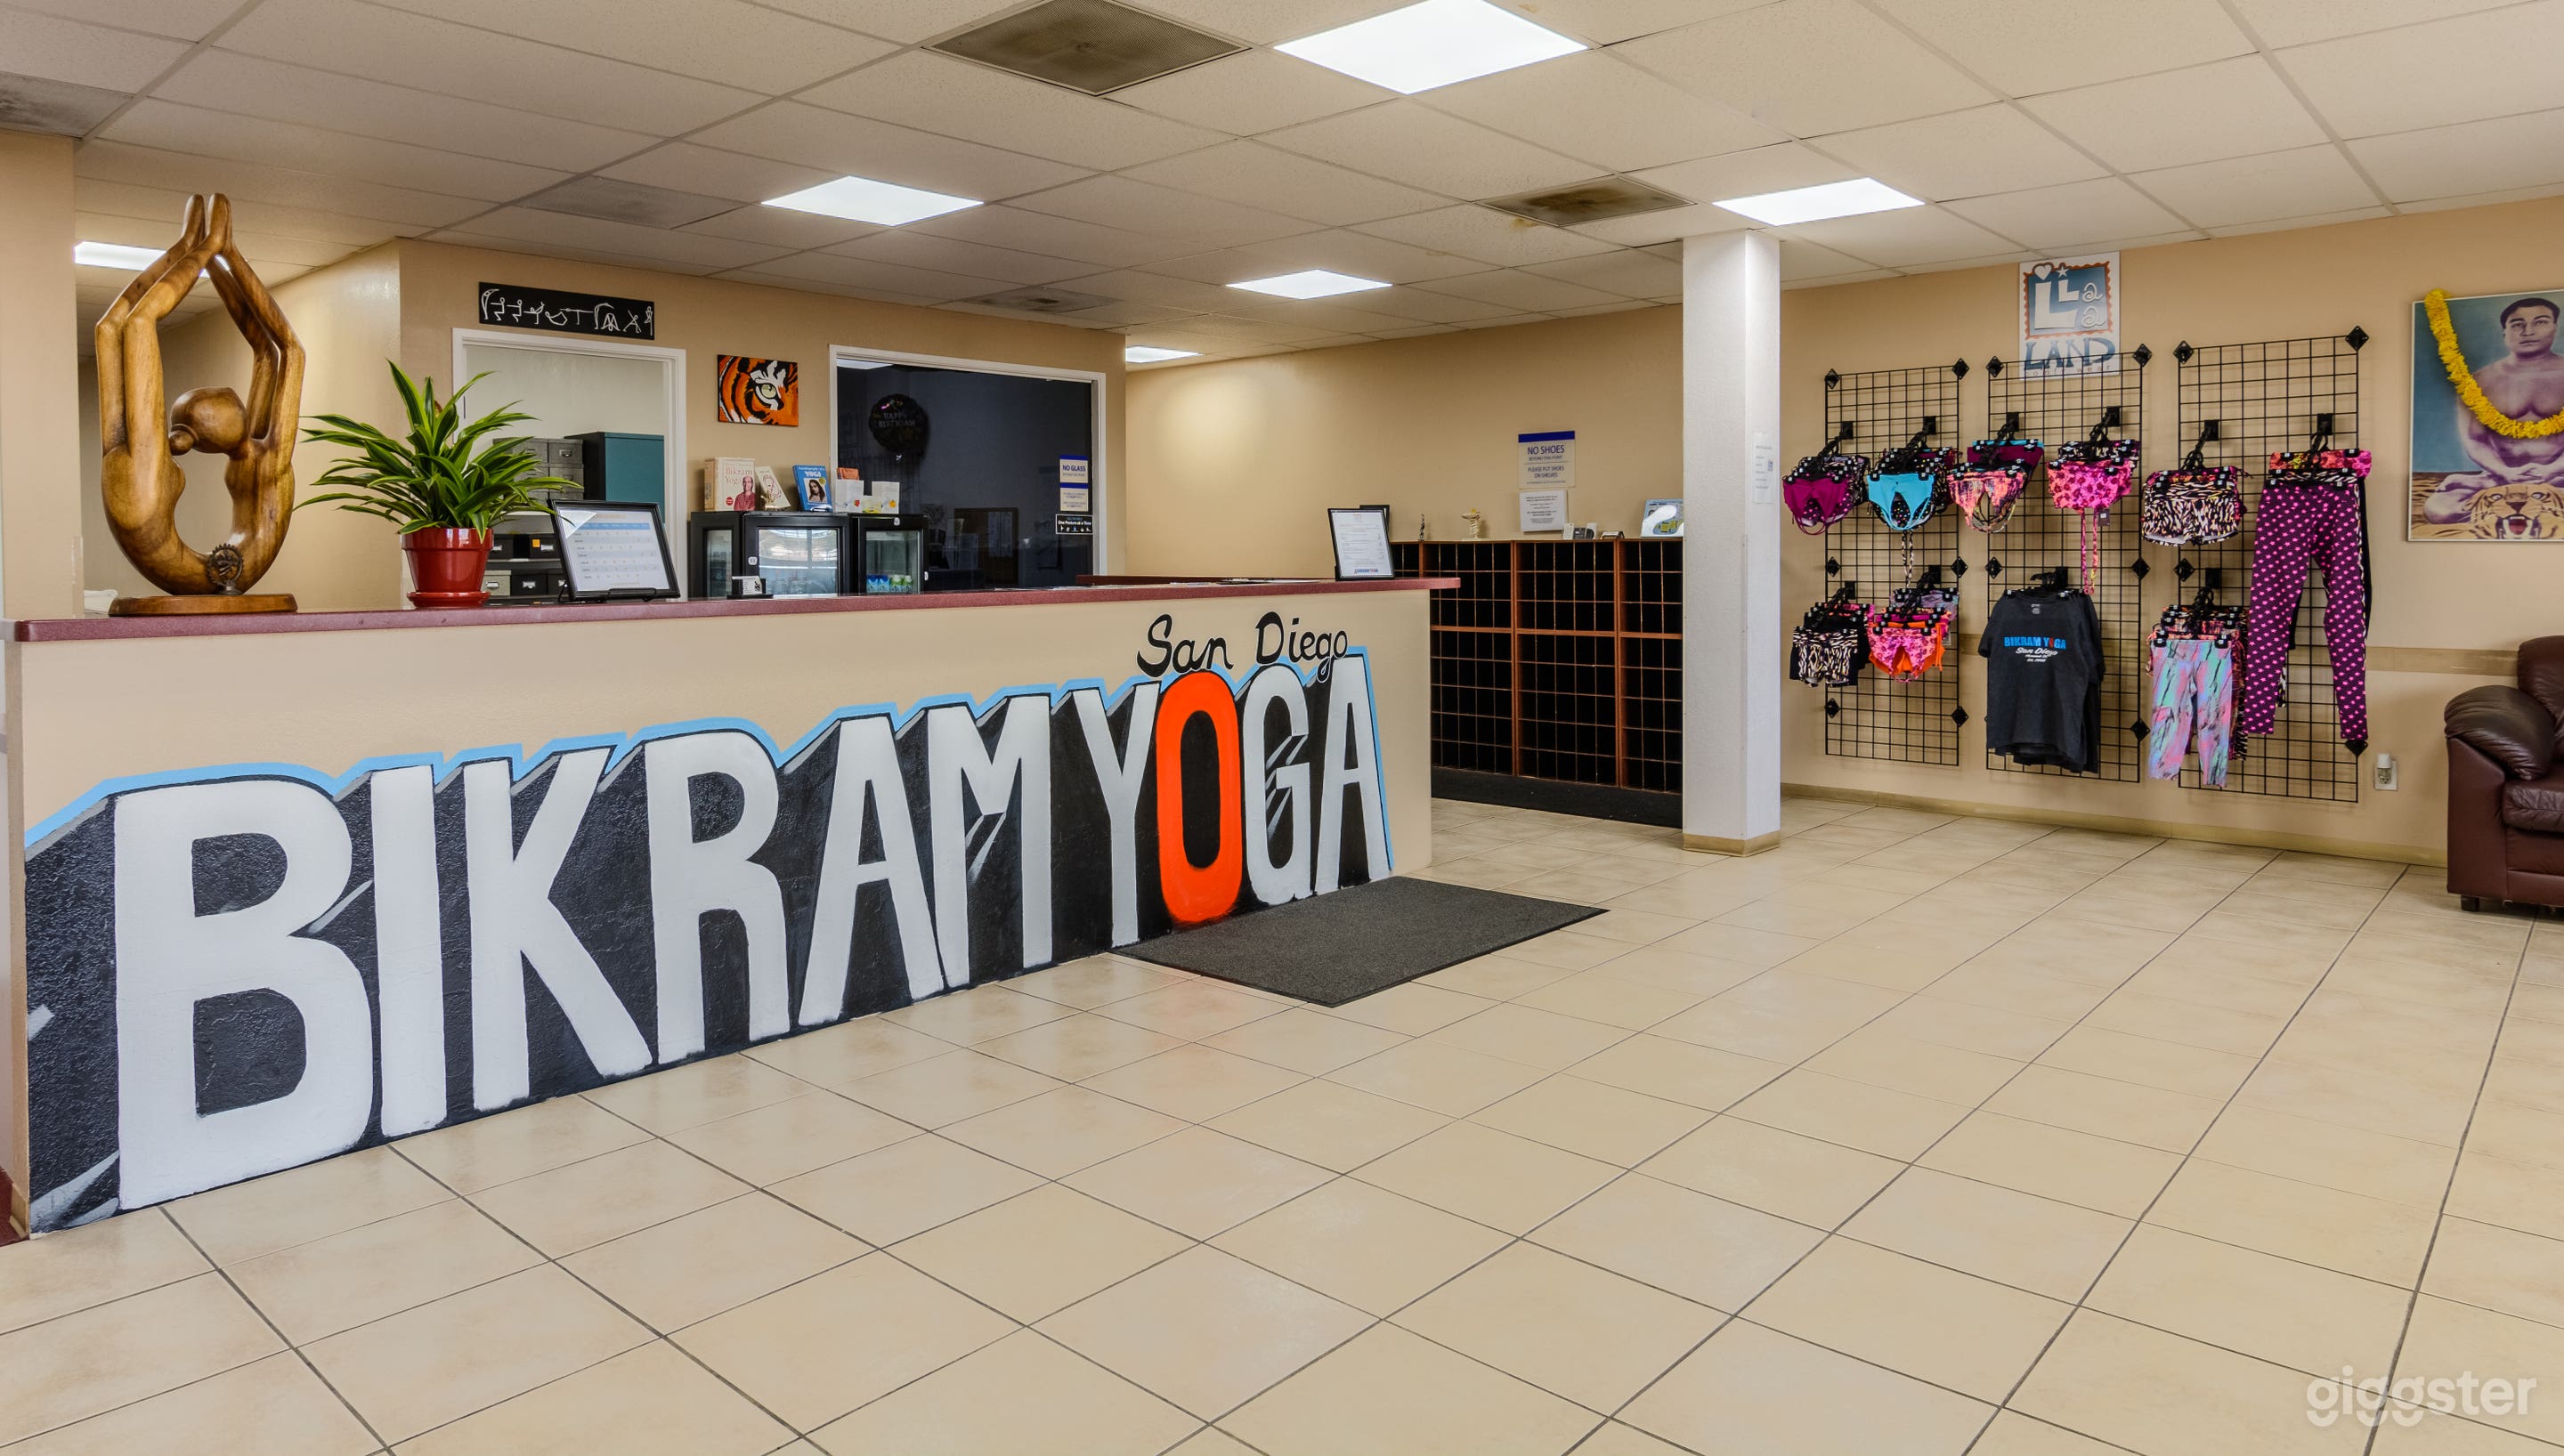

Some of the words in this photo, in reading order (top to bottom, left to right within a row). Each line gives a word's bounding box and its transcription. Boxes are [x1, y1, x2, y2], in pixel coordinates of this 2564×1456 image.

[2024, 337, 2115, 370] LAND
[1527, 446, 1539, 455] NO
[1540, 444, 1565, 455] SHOES
[726, 466, 753, 476] Bikram
[1071, 465, 1086, 473] GLASS
[725, 476, 742, 488] Yoga
[1136, 613, 1235, 678] San
[1255, 611, 1348, 683] Diego
[2004, 636, 2041, 647] BIKRAM
[2043, 636, 2066, 650] YOGA
[2034, 647, 2058, 657] Diego
[113, 692, 1052, 1210] BIKRAM
[1071, 656, 1391, 949] YOGA
